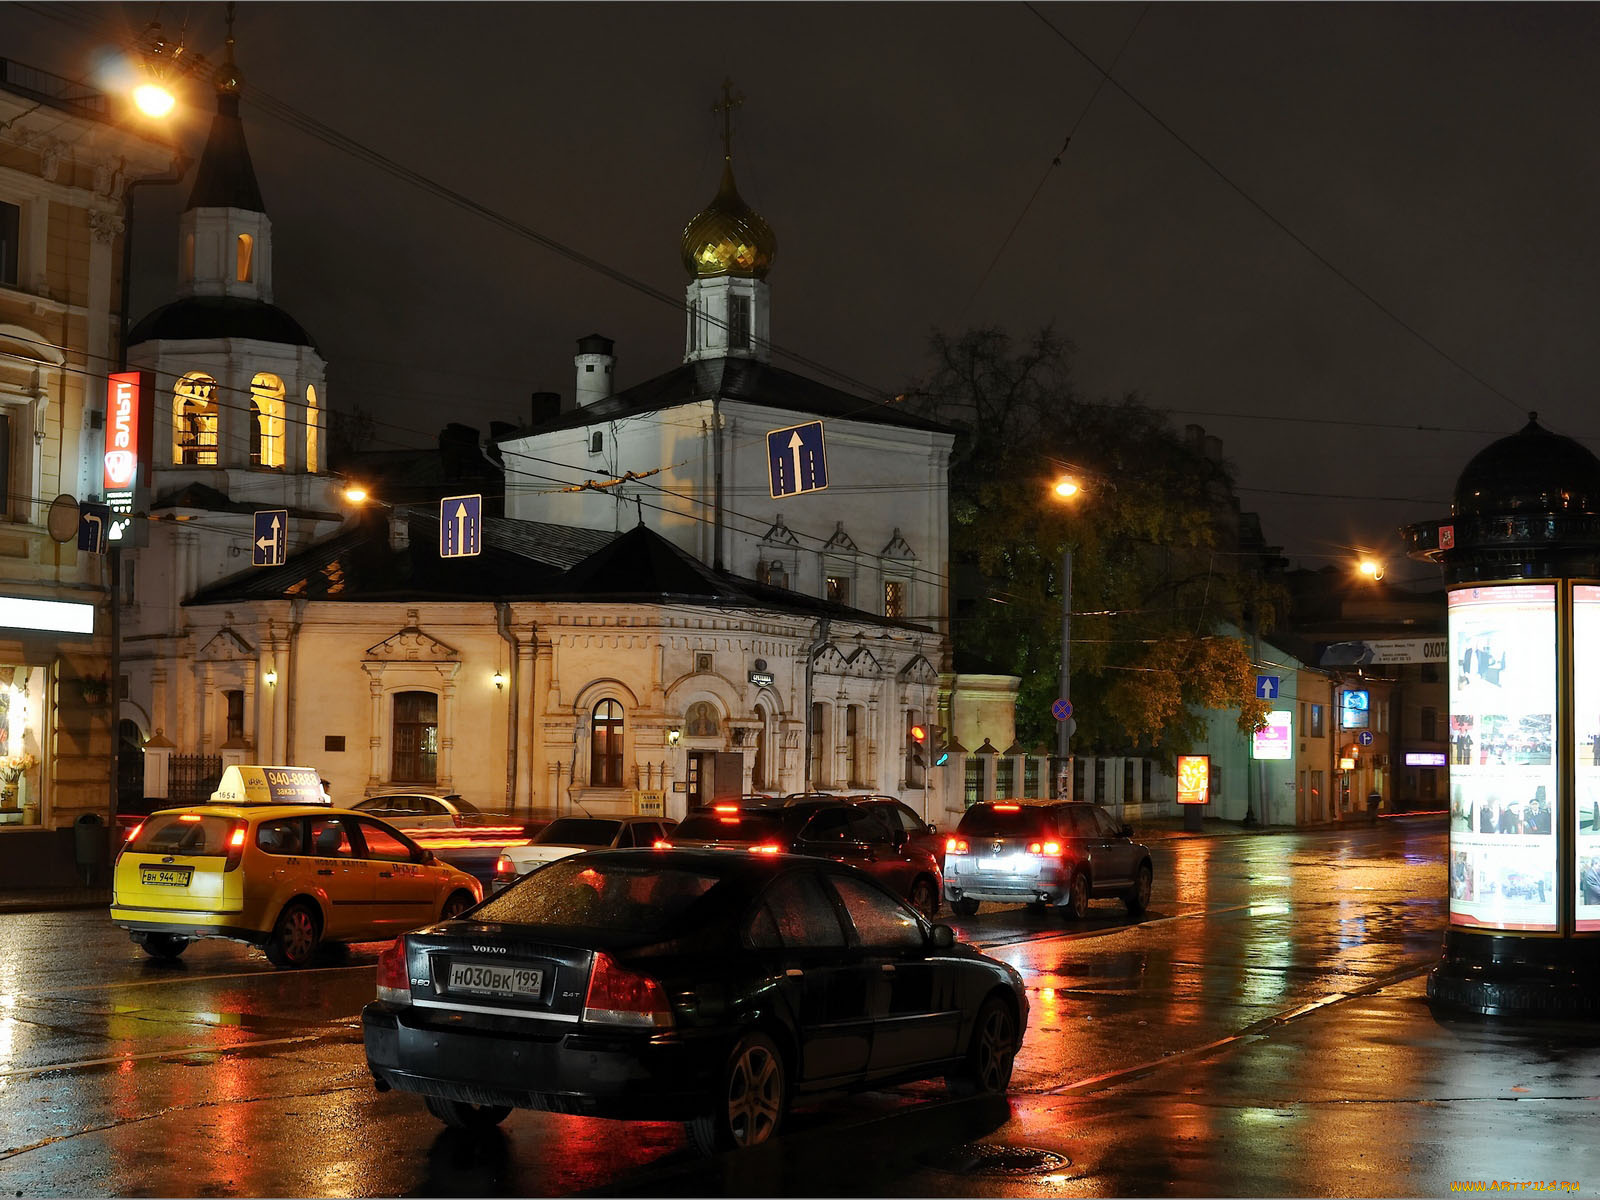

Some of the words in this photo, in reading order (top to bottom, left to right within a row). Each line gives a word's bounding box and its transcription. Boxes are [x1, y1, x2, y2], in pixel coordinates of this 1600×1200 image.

[269, 772, 318, 786] 940-8888
[219, 791, 236, 800] 1654
[160, 872, 173, 882] 944
[178, 872, 186, 880] 77
[472, 944, 507, 954] VOLVO
[411, 977, 430, 988] S60
[514, 970, 538, 986] 199
